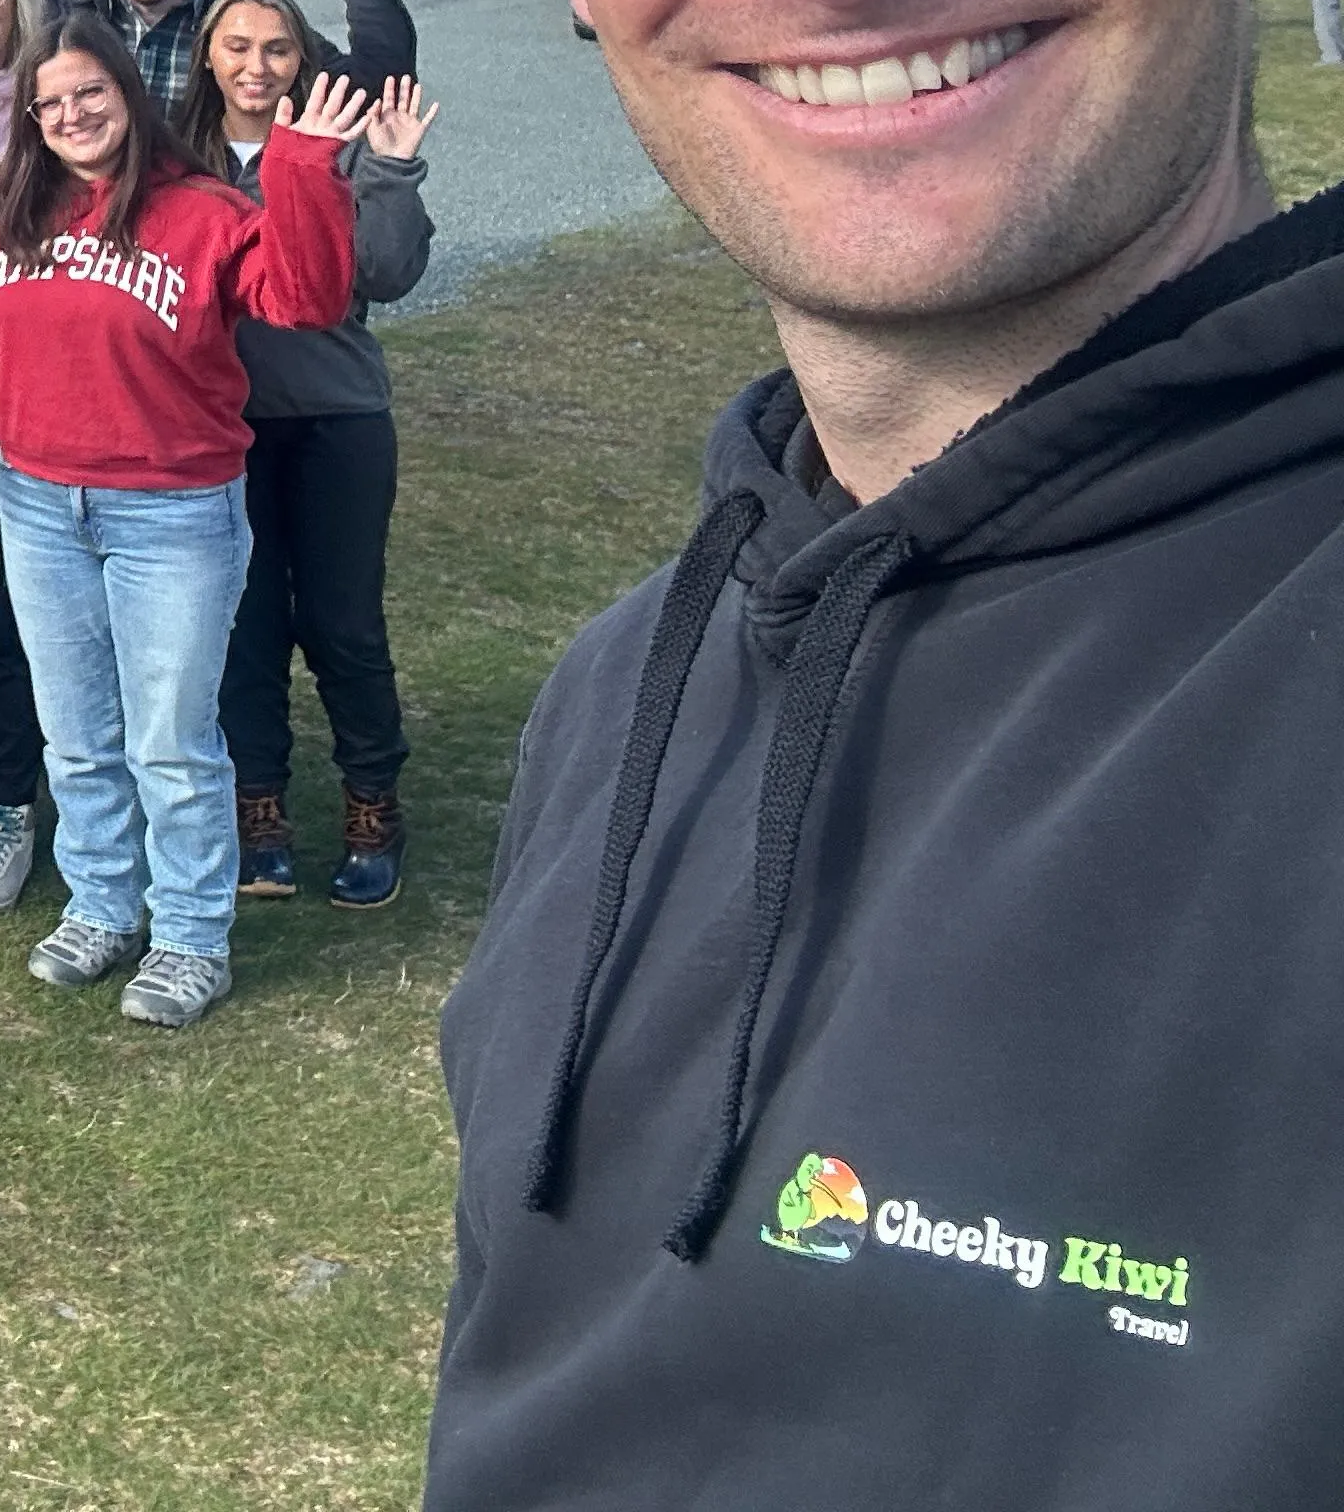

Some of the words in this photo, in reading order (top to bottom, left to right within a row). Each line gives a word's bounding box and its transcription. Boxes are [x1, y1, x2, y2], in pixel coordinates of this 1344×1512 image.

[875, 1199, 1049, 1288] Cheeky
[1058, 1237, 1189, 1306] Kiwi
[1109, 1306, 1188, 1346] Travel
